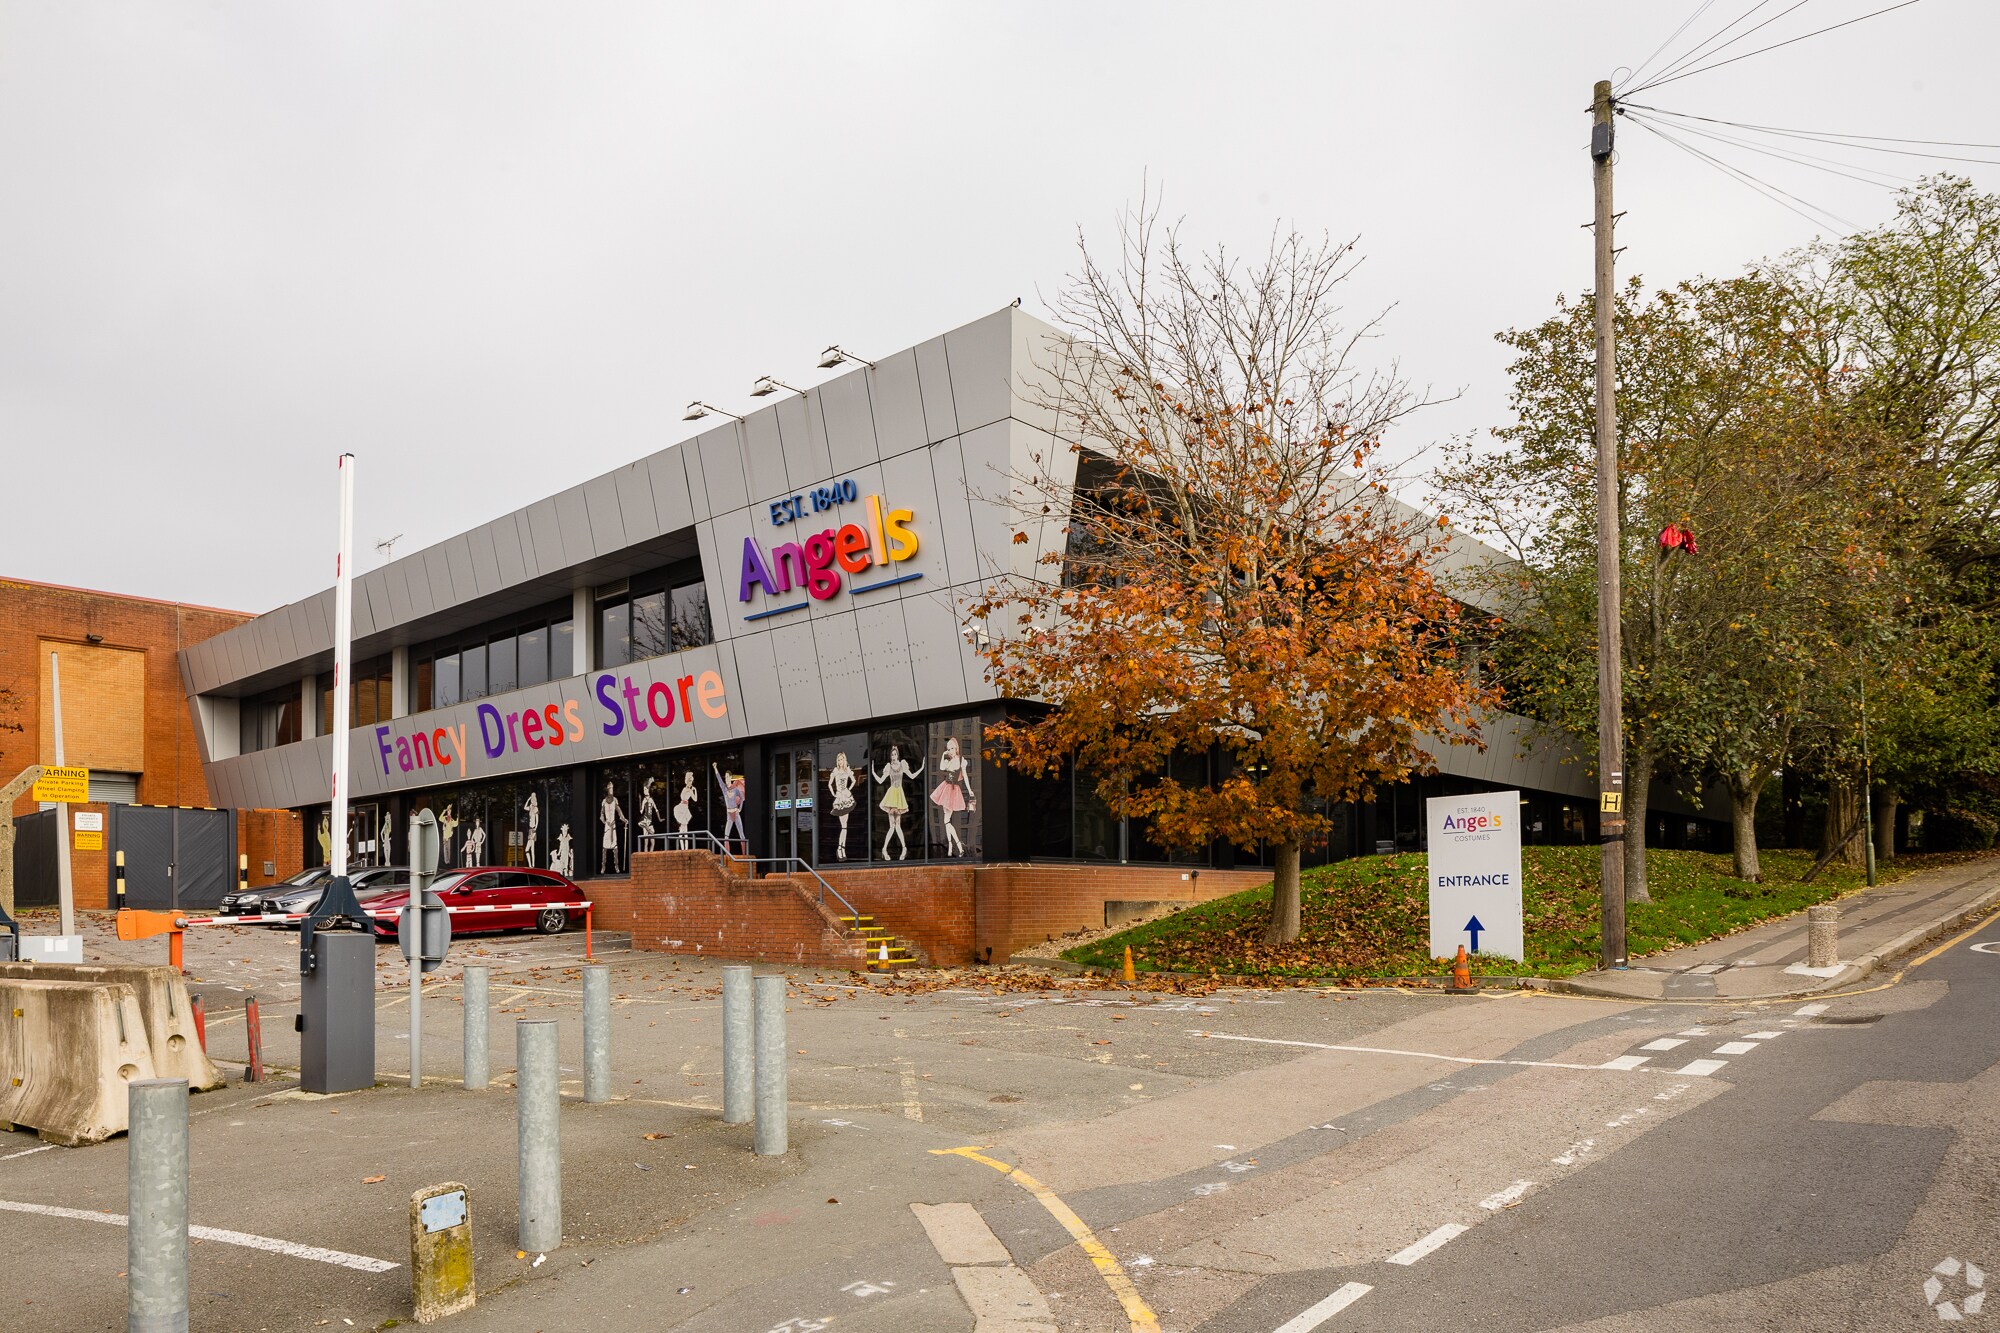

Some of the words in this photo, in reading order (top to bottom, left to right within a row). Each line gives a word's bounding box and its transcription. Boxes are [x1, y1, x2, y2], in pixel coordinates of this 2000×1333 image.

[769, 494, 809, 526] EST.
[809, 478, 857, 513] 1840
[739, 494, 919, 602] Angels
[375, 722, 467, 778] Fancy
[476, 699, 585, 760] Dress
[596, 669, 728, 736] Store
[44, 769, 85, 778] ARNING
[1604, 794, 1618, 810] H
[1443, 811, 1501, 832] Angels
[1454, 834, 1491, 842] COSTUMES
[1438, 874, 1510, 888] ENTRANCE
